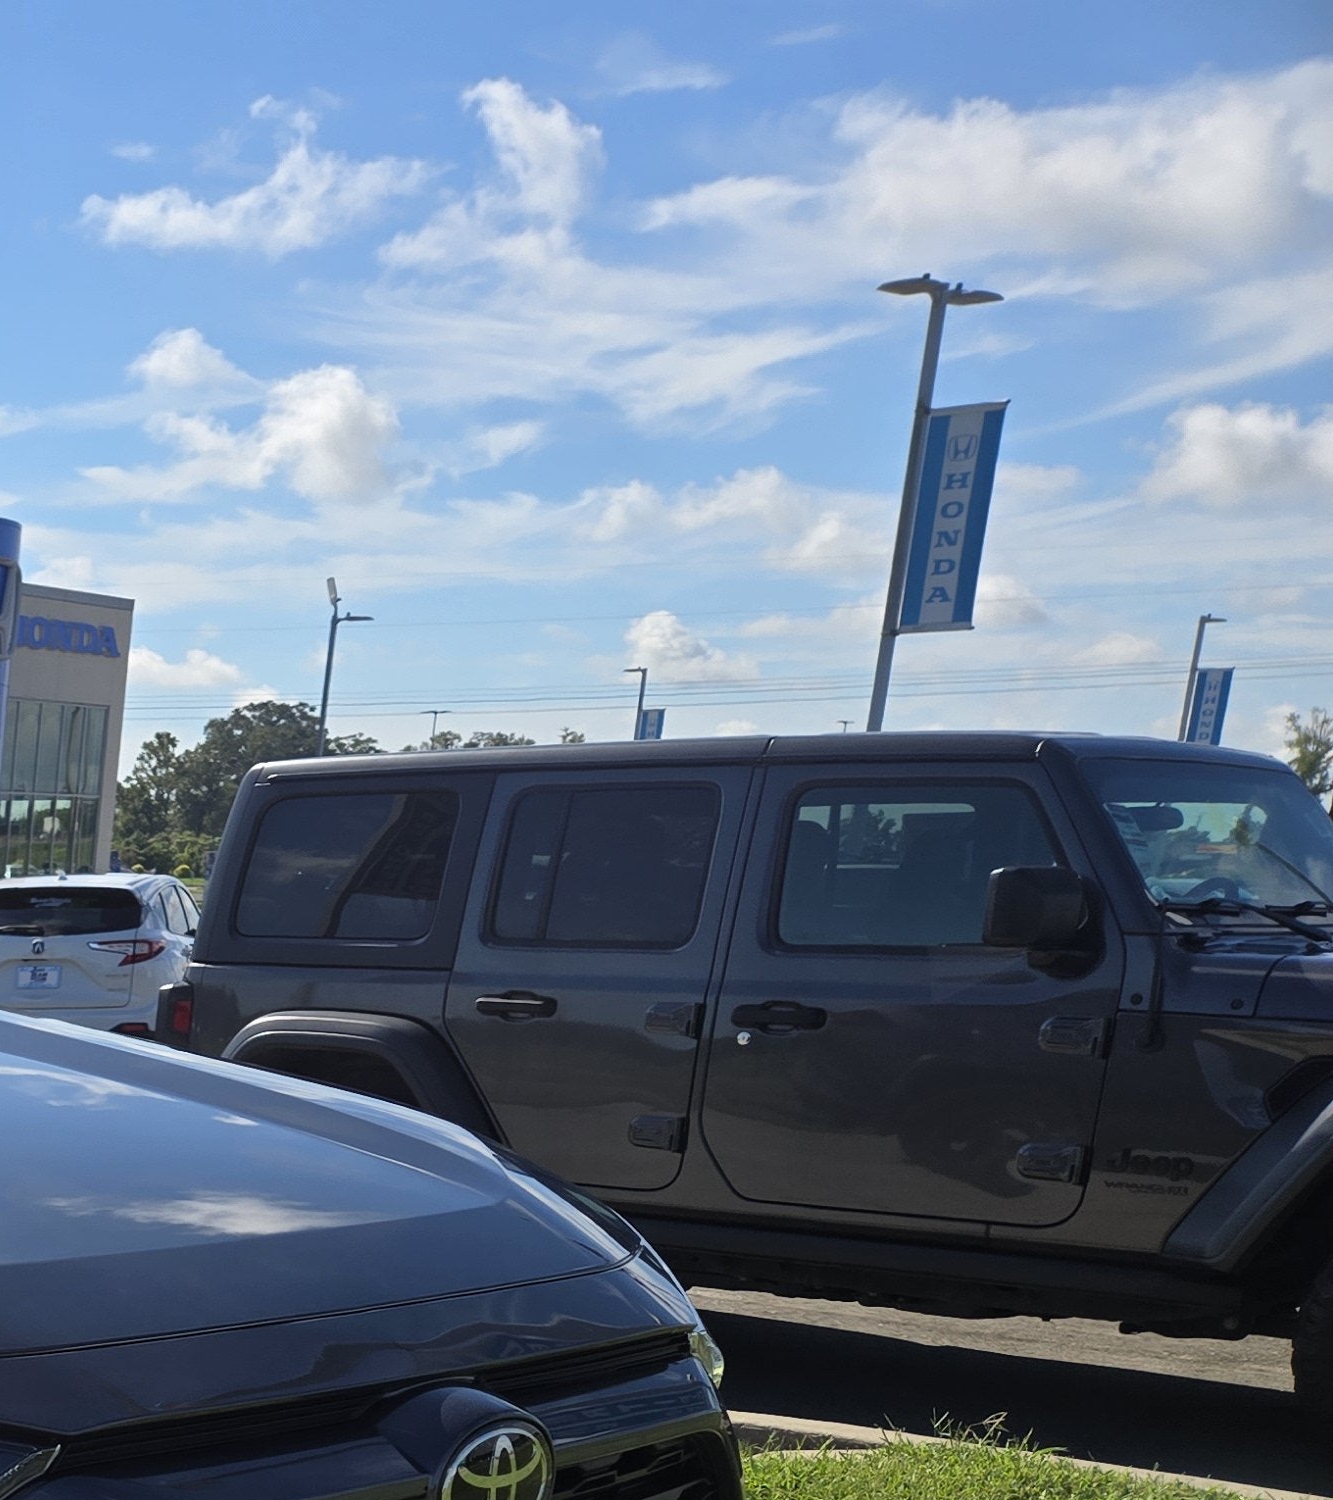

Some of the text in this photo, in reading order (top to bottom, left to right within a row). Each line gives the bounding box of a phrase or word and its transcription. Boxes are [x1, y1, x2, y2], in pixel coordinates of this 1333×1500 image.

[925, 471, 970, 604] HONDA
[1198, 696, 1216, 741] HOND
[1106, 1148, 1194, 1182] Jeep
